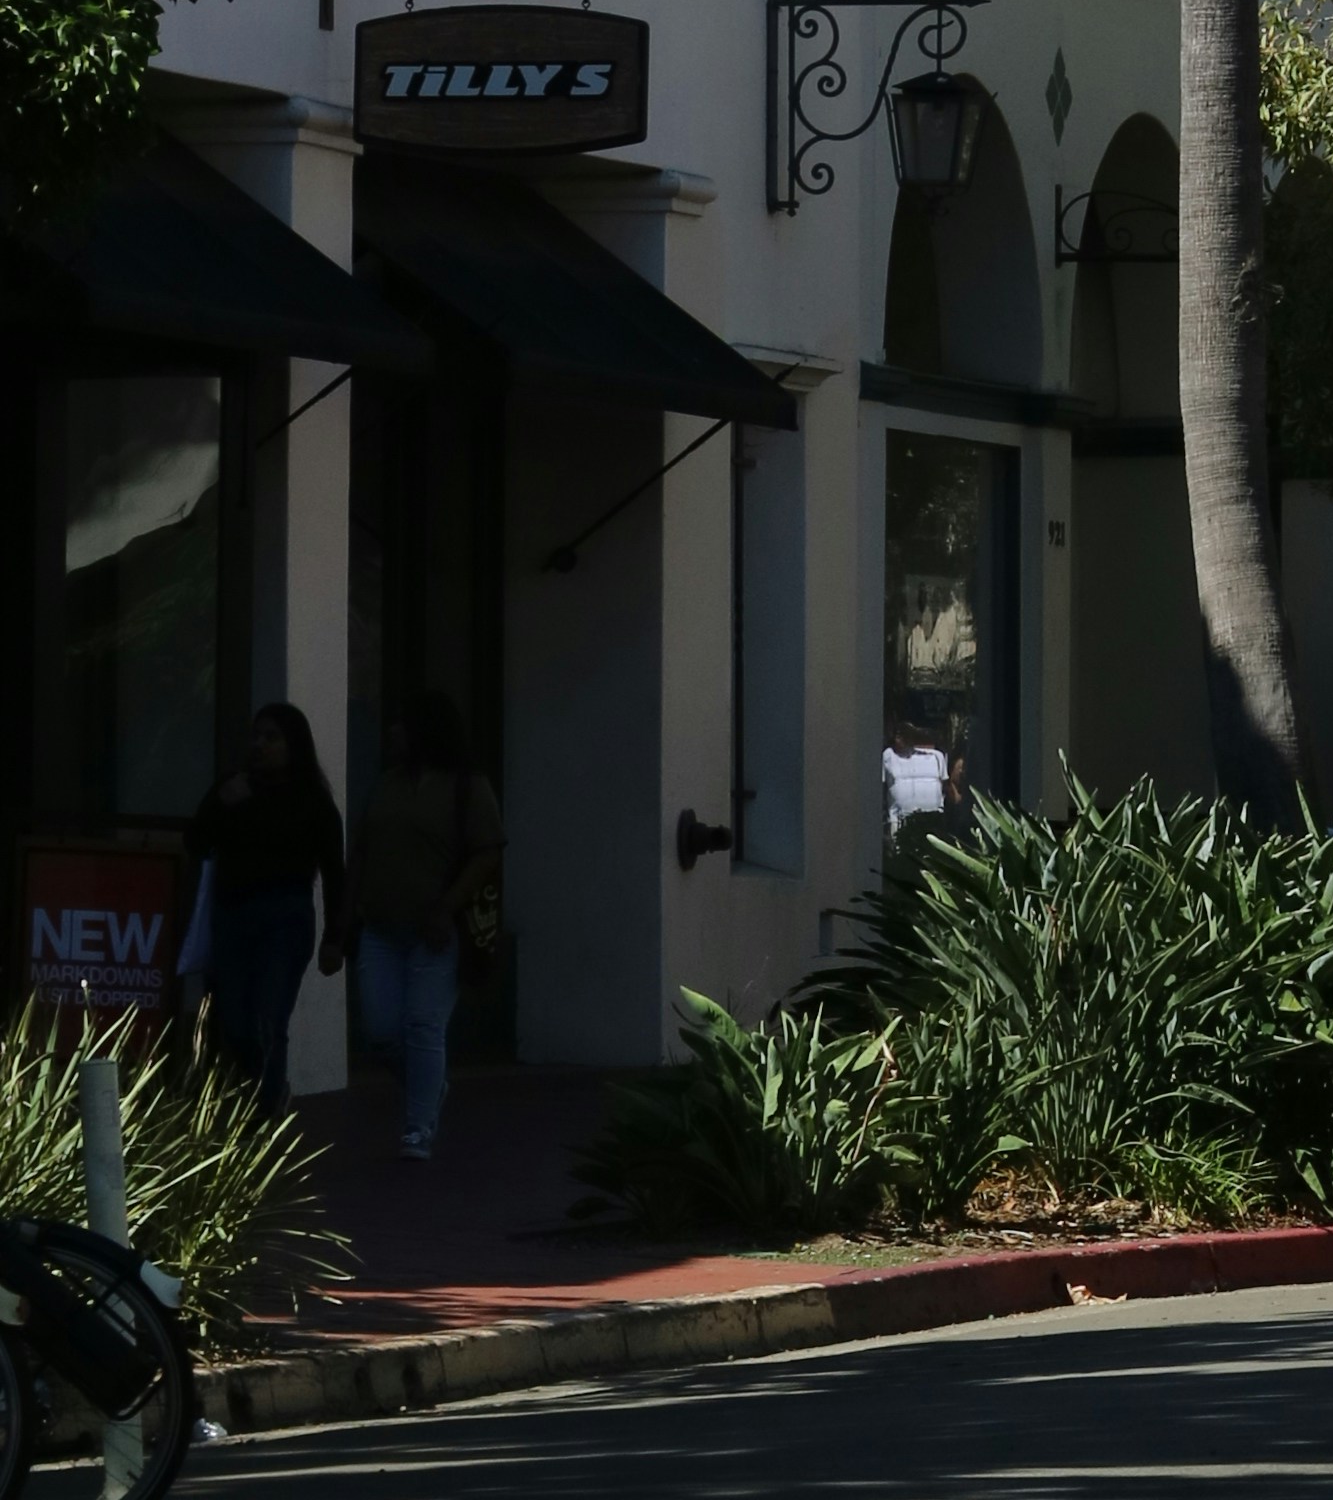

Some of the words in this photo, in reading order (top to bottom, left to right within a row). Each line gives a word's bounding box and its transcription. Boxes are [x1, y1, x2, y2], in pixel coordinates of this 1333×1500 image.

[32, 907, 165, 964] NEW
[30, 962, 163, 988] MARKDOWNS
[35, 987, 71, 1003] UST
[75, 988, 160, 1009] DROPPED!
